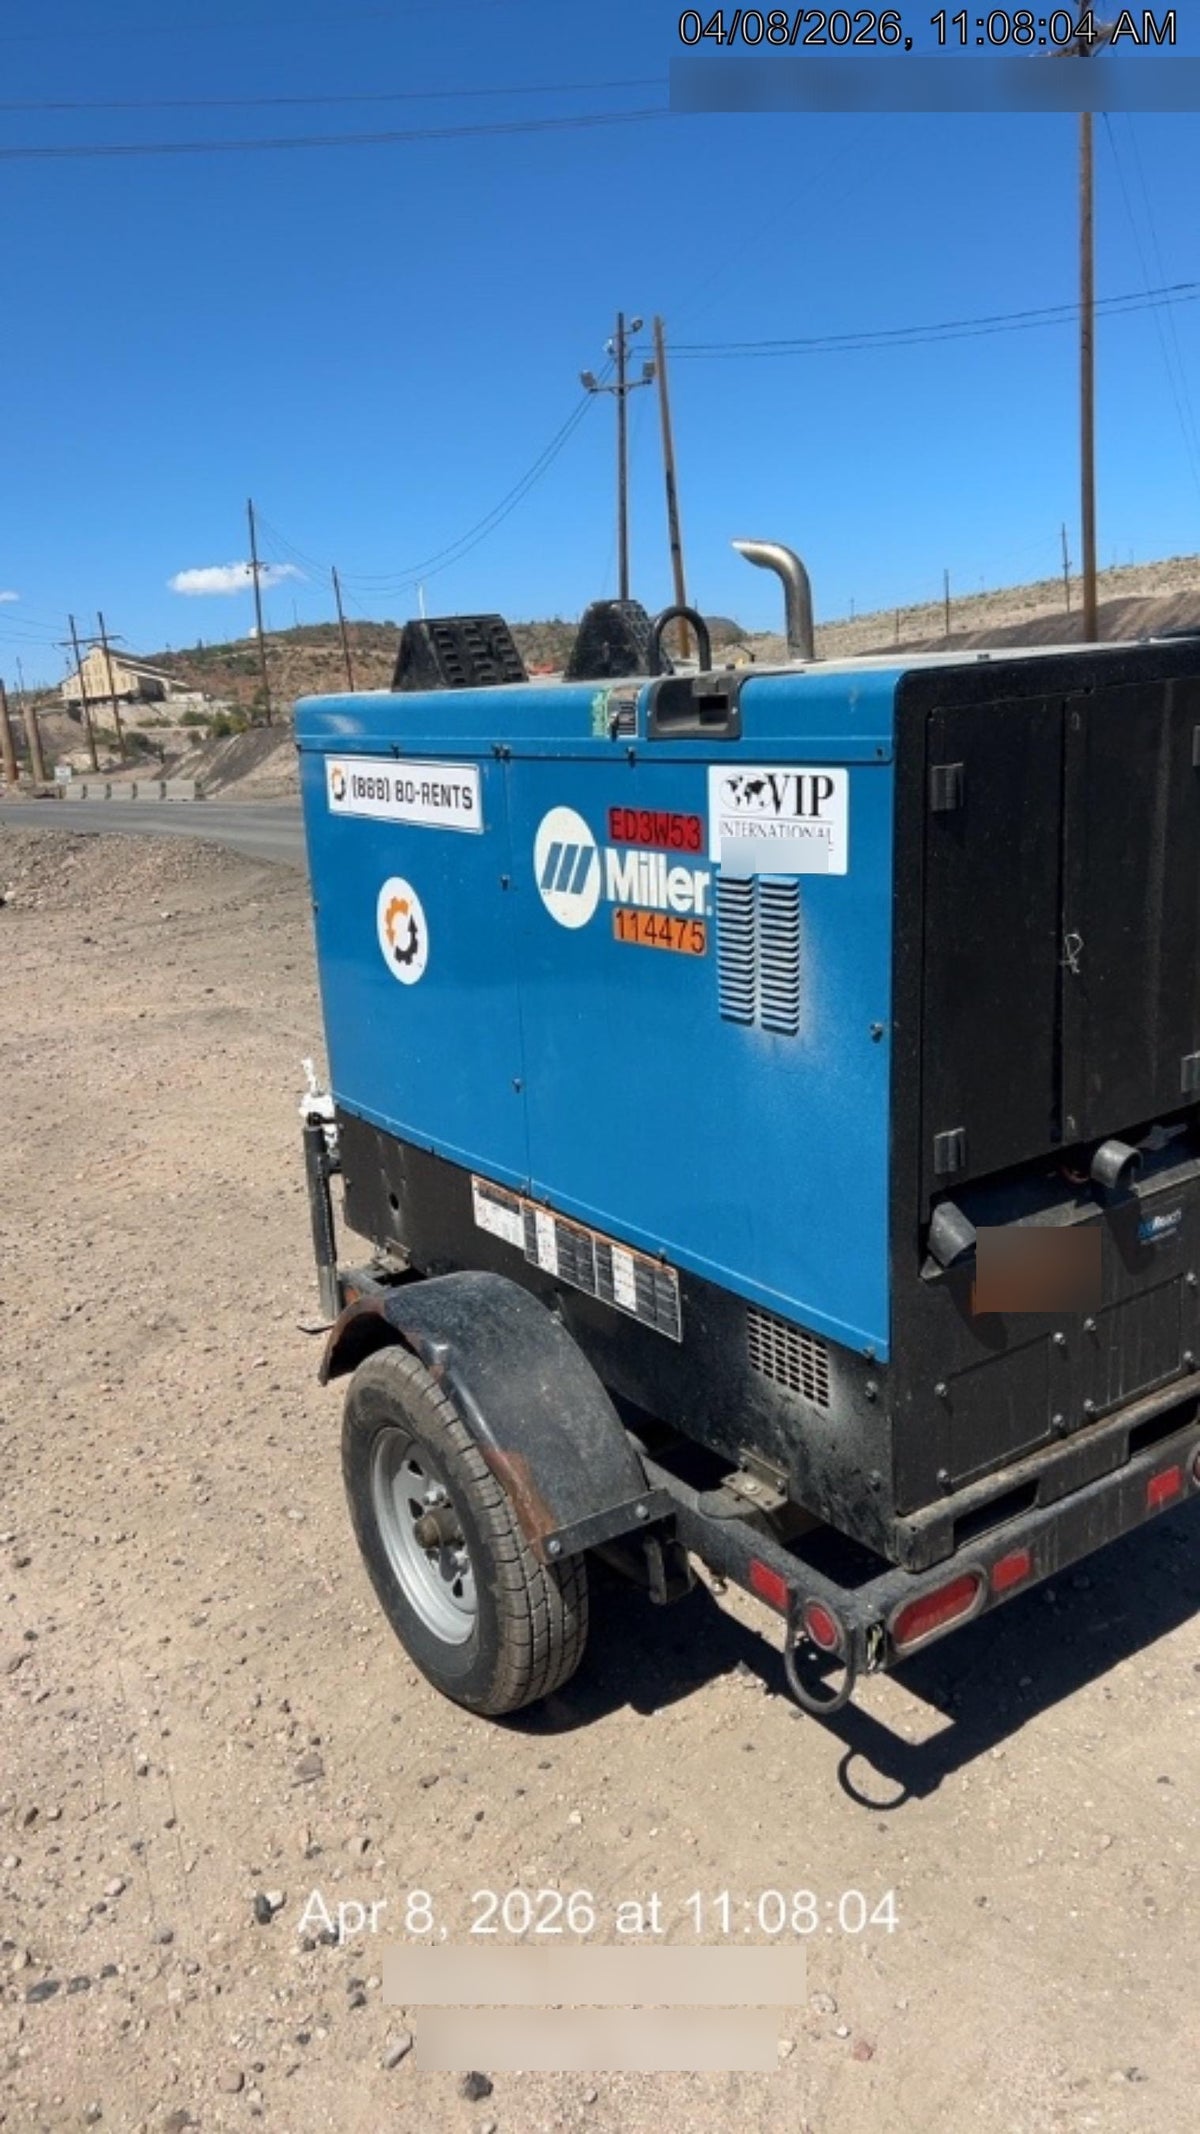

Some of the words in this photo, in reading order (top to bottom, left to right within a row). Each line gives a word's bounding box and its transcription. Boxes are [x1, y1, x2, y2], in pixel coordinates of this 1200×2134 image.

[352, 774, 390, 802] (888)
[764, 773, 835, 817] VIP
[609, 806, 701, 850] ED3W53
[616, 909, 705, 954] 114475
